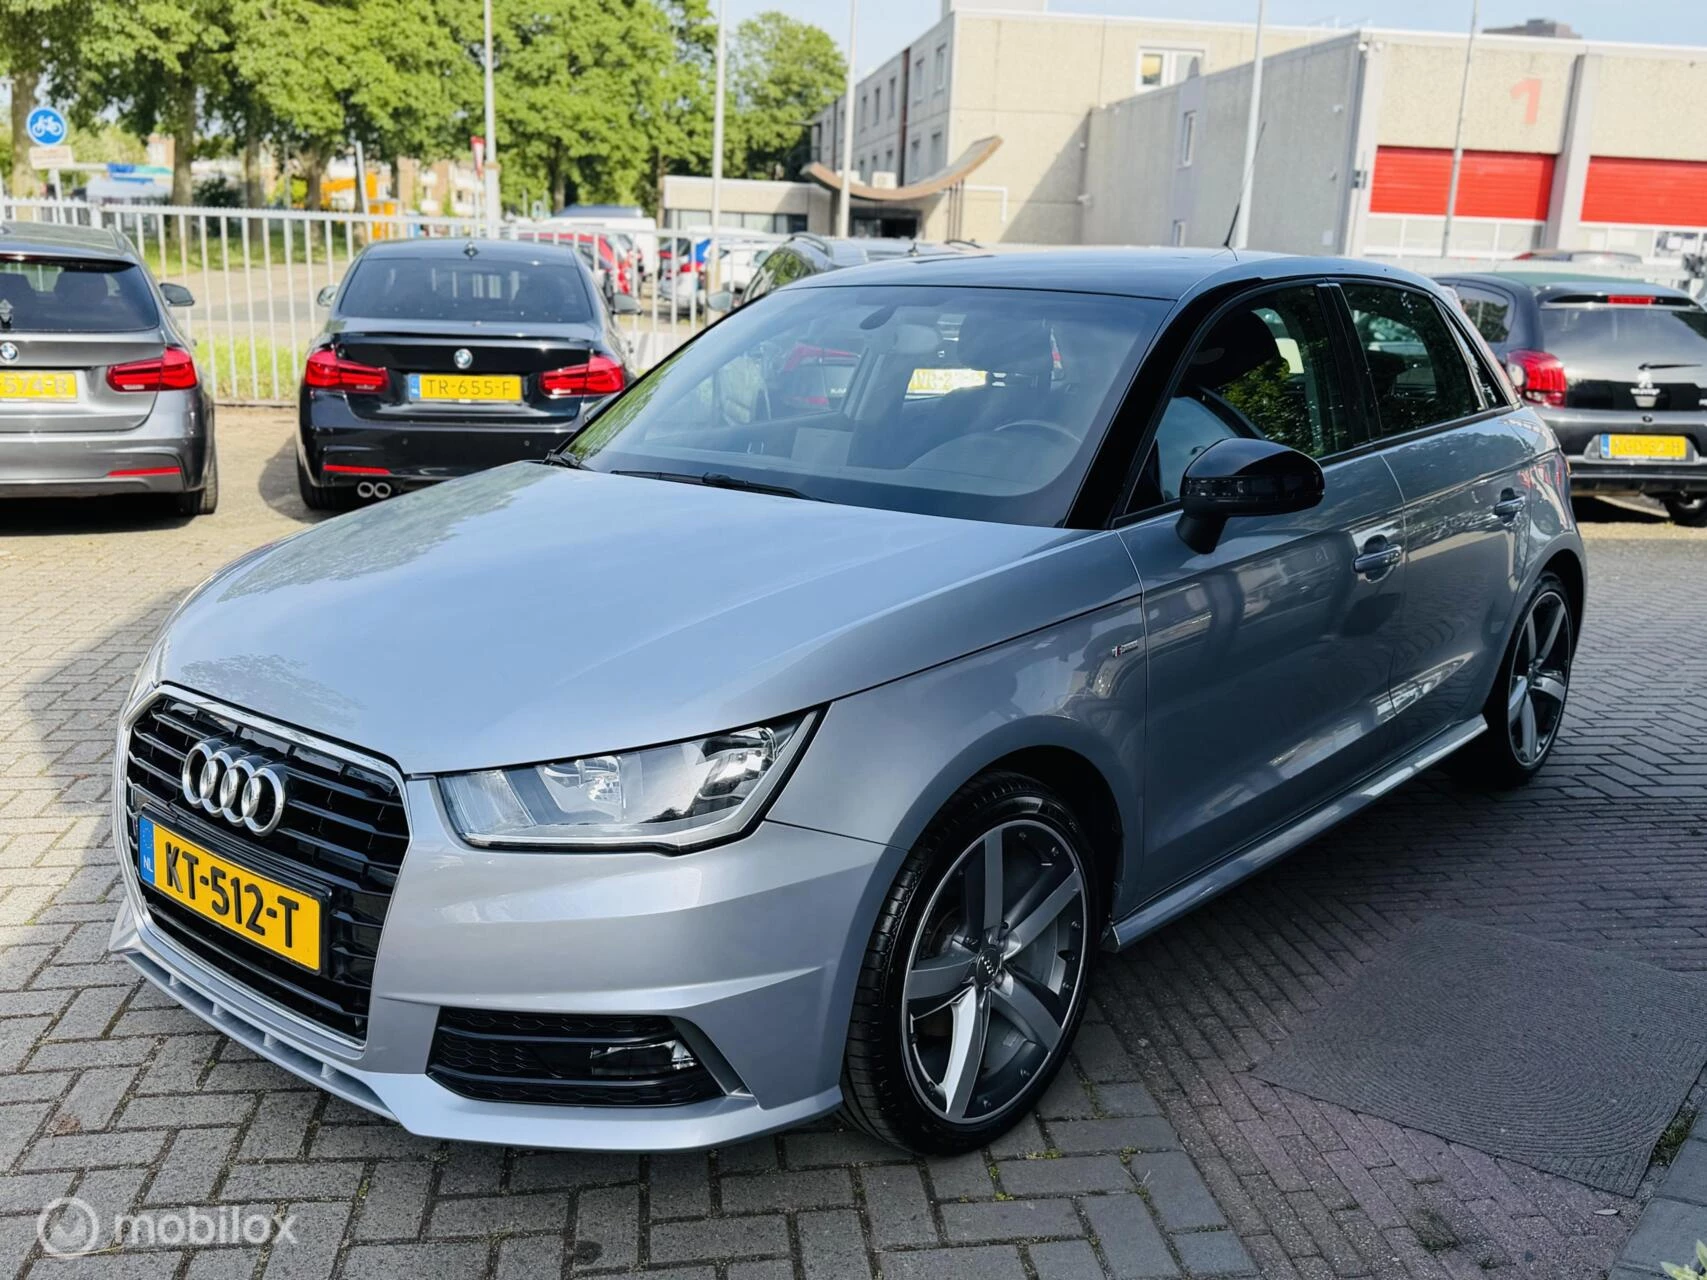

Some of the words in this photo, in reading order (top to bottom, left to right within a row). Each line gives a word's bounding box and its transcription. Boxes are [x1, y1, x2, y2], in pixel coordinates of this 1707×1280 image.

[1509, 79, 1541, 124] 1
[0, 376, 67, 394] 574-B
[427, 379, 511, 396] TR-655-F
[143, 855, 154, 873] NL
[165, 841, 299, 948] KT-512-T
